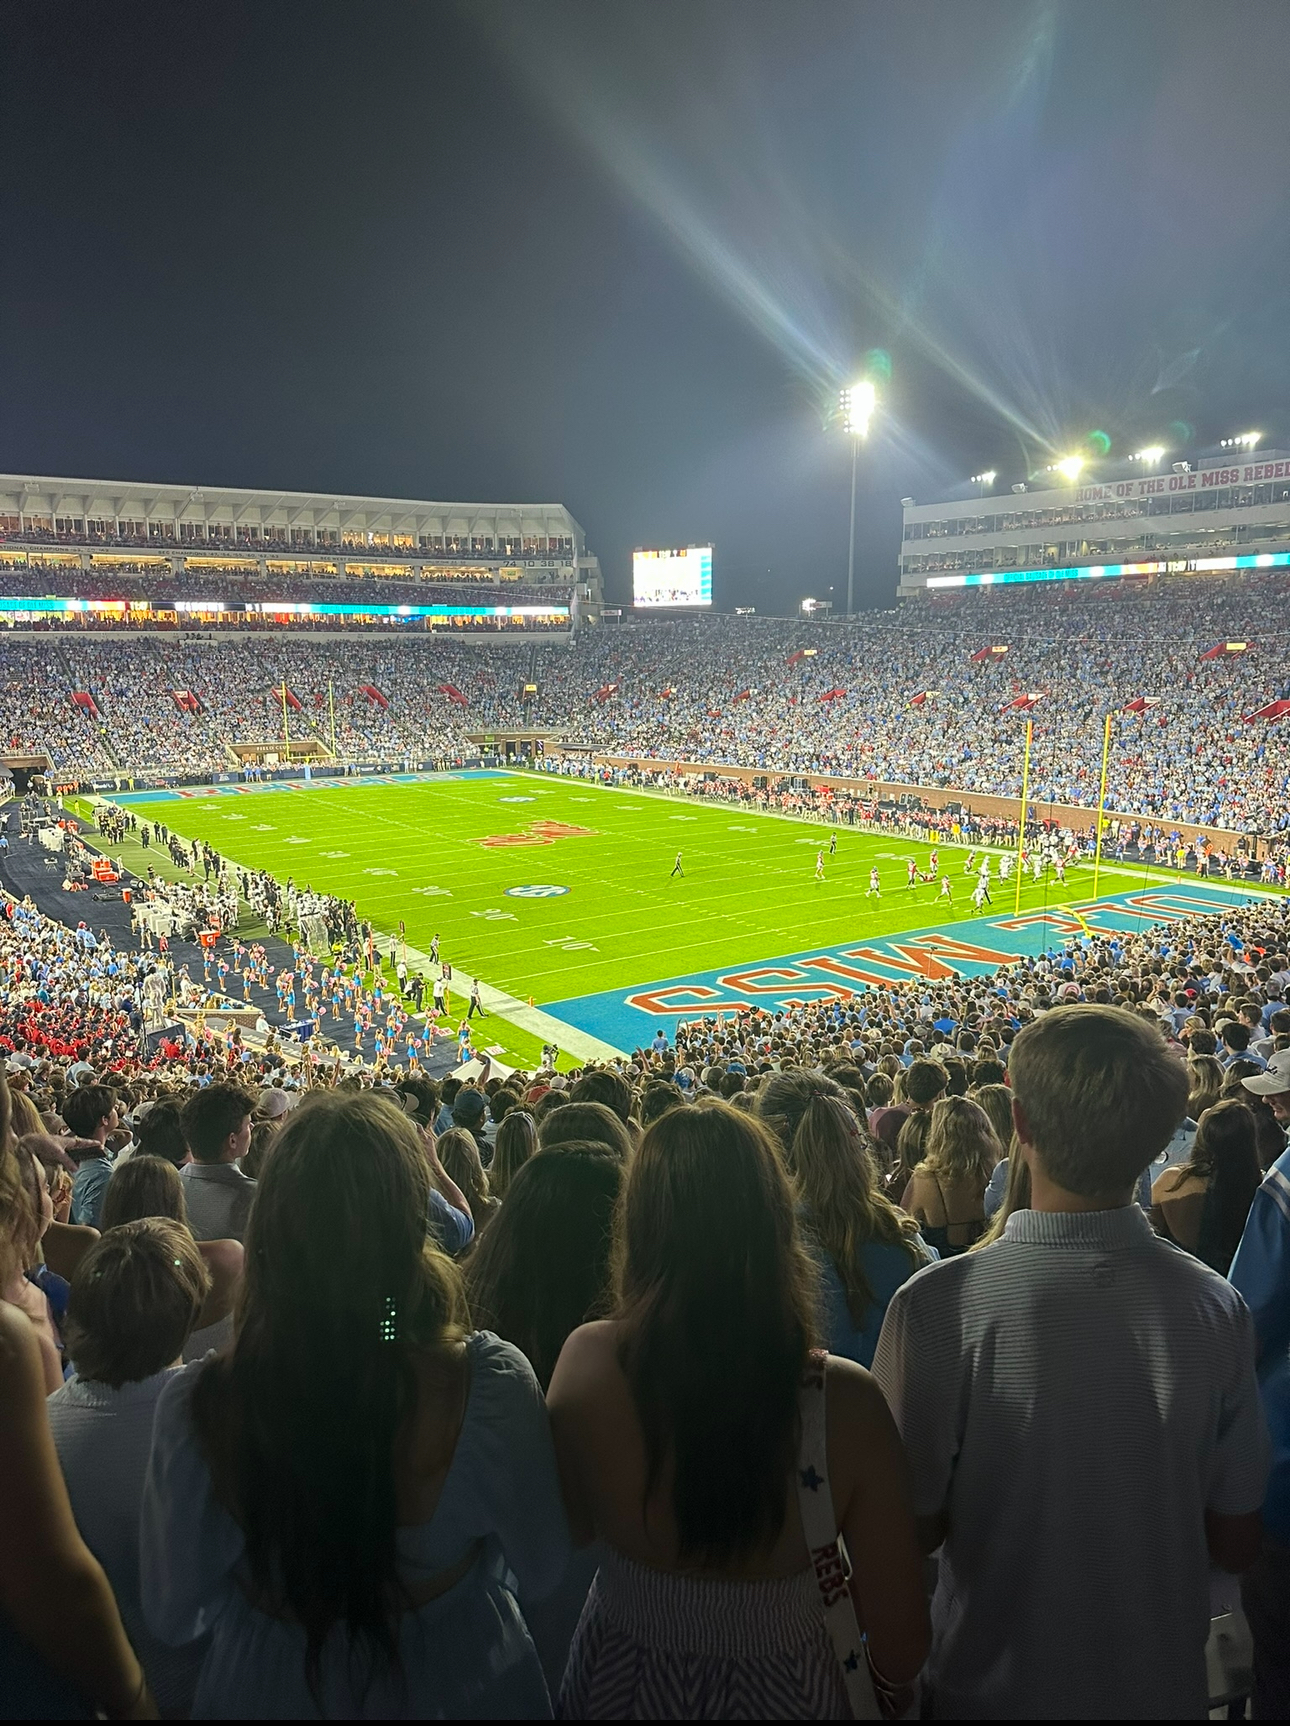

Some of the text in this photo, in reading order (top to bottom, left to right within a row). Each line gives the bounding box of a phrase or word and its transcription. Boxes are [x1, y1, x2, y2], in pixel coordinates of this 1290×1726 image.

[1075, 485, 1112, 502] HOME
[1116, 482, 1133, 498] OF
[1138, 479, 1165, 495] THE
[1169, 474, 1197, 491] OLE
[1201, 468, 1240, 488] MISS
[523, 560, 535, 568] 10
[206, 935, 214, 943] G
[542, 935, 593, 951] 10
[811, 1541, 849, 1607] REBS
